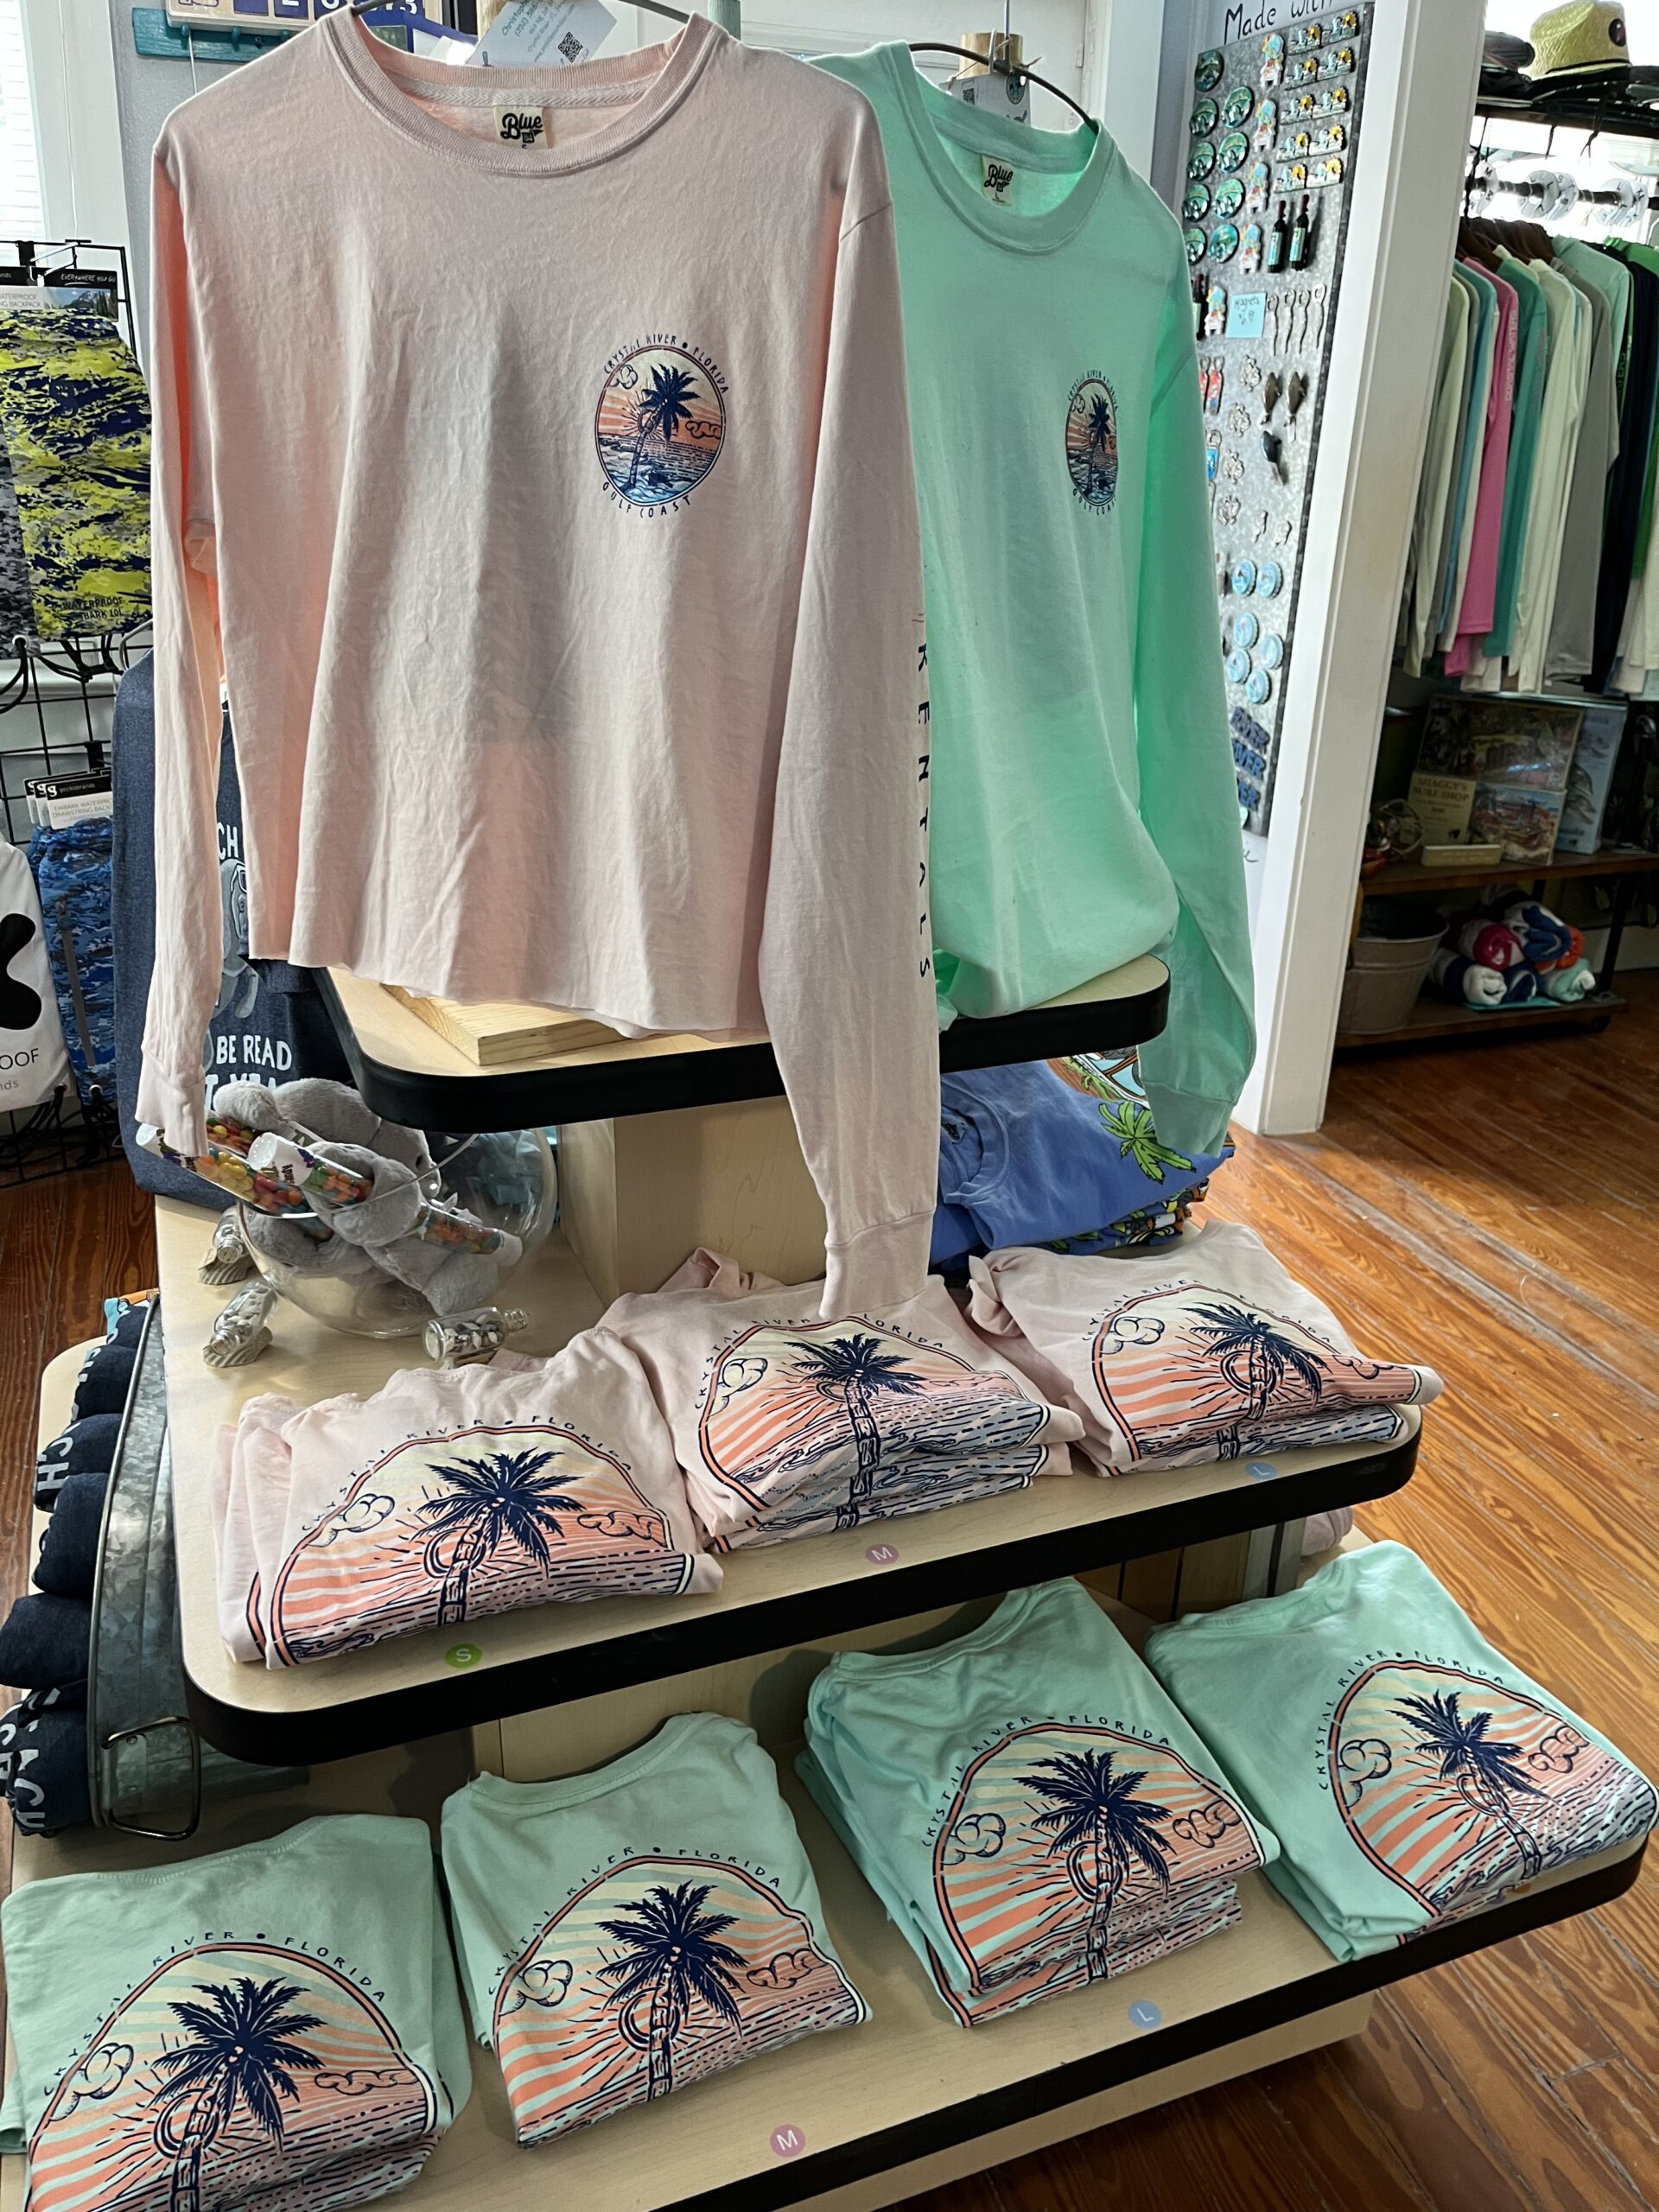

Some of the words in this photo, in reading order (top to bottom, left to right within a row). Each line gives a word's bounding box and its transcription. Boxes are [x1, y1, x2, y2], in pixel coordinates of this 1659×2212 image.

[1224, 0, 1277, 45] Made
[500, 113, 543, 140] Blue
[984, 164, 1014, 188] Blue
[60, 274, 96, 283] EVERYWHERE
[604, 338, 641, 374] CRYSTAL
[646, 334, 677, 346] RIVER
[693, 347, 729, 394] FLORIDA
[602, 481, 632, 513] GULF
[640, 495, 691, 518] COAST
[216, 1034, 237, 1065] BE
[243, 1034, 293, 1071] READ
[694, 1328, 742, 1409] CRYSTAL
[864, 1313, 944, 1349] LORIDA
[301, 1447, 389, 1532] CRYSTAL
[407, 1417, 484, 1440] RIVER
[531, 1414, 632, 1471] FLORIDA
[870, 1547, 893, 1561] M
[455, 1647, 472, 1663] S
[1319, 1700, 1337, 1789] CRYSTAL
[1337, 1649, 1388, 1688] RIVER
[1414, 1650, 1505, 1686] FLORIDA
[923, 1764, 966, 1847] CRYSTAL
[971, 1715, 1033, 1753] RIVER
[1069, 1713, 1170, 1747] FLORIDA
[487, 1910, 555, 1995] CRYSTAL
[566, 1847, 635, 1897] RIVER
[678, 1848, 781, 1889] FLORIDA
[42, 1982, 137, 2096] CRYSTAL
[152, 1930, 235, 1967] RIVER
[284, 1936, 386, 2002] FLORIDA
[1136, 2006, 1154, 2023] L
[776, 2129, 800, 2151] M
